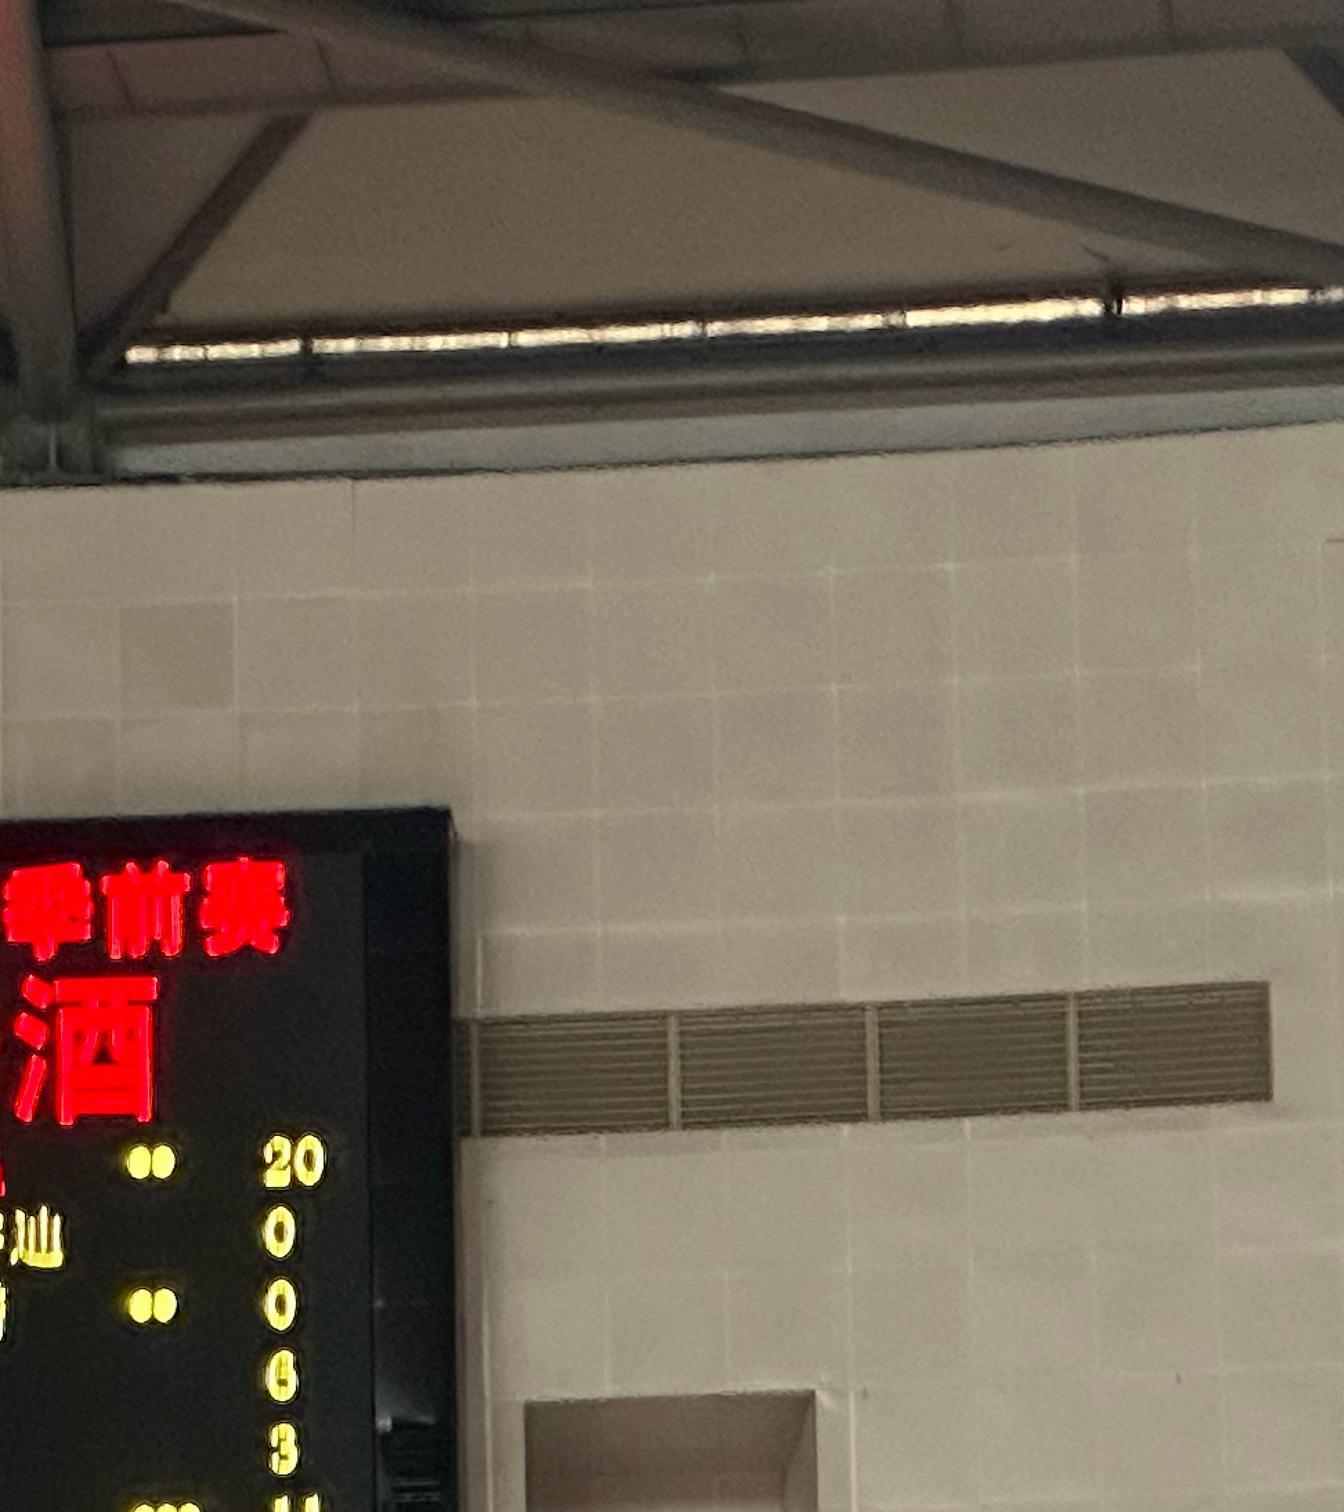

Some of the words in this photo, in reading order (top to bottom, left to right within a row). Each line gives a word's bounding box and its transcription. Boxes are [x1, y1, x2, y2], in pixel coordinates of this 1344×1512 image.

[263, 1135, 326, 1187] 20
[262, 1206, 295, 1257] 0
[263, 1280, 296, 1331] 0
[265, 1350, 299, 1401] 6
[269, 1423, 298, 1474] 3
